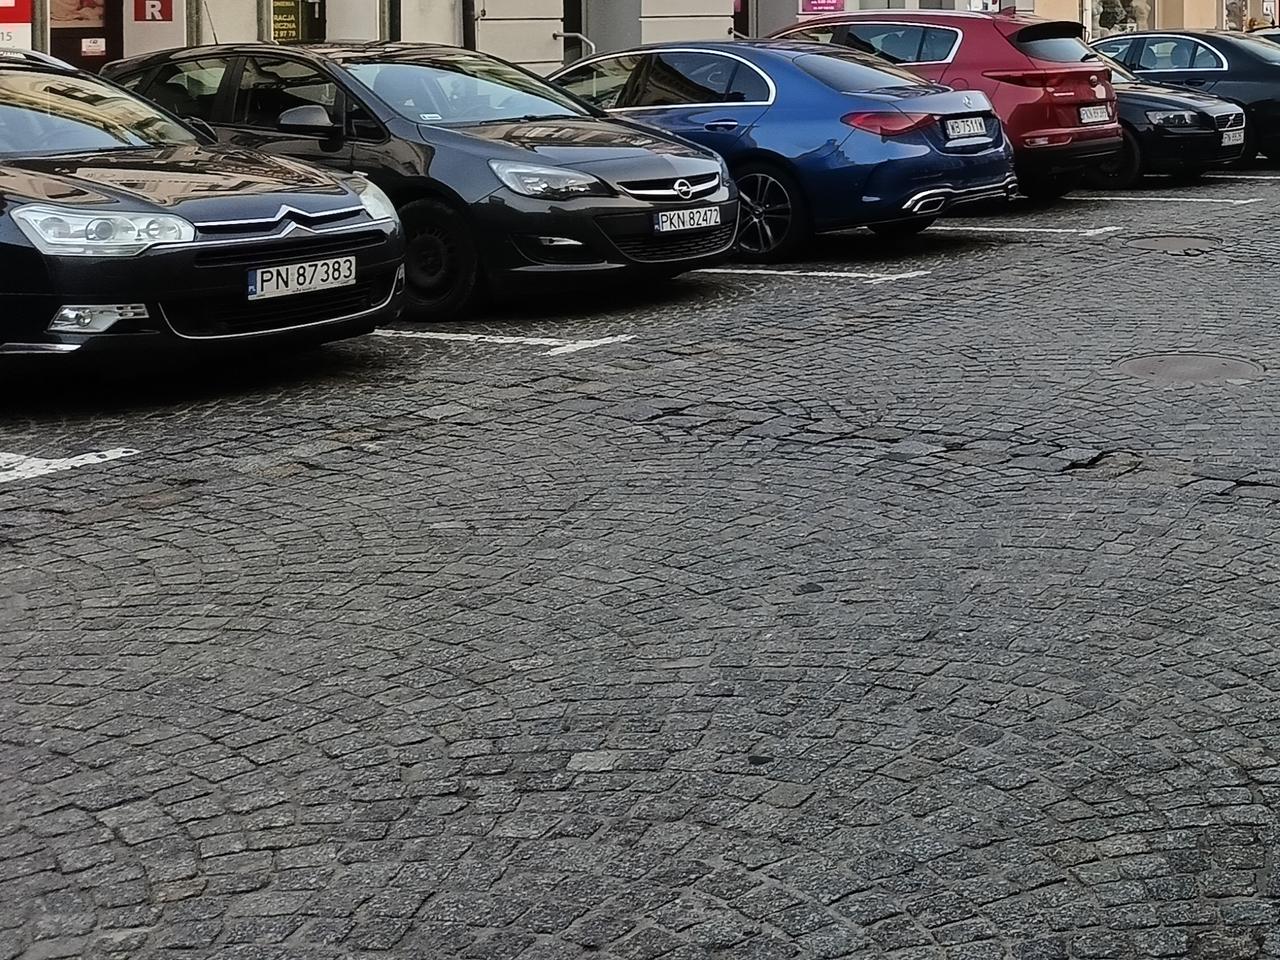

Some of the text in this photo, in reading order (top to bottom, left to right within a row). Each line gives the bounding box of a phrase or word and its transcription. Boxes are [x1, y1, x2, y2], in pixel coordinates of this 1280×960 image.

[660, 208, 719, 231] PKN 82472
[260, 259, 353, 292] PN 87383
